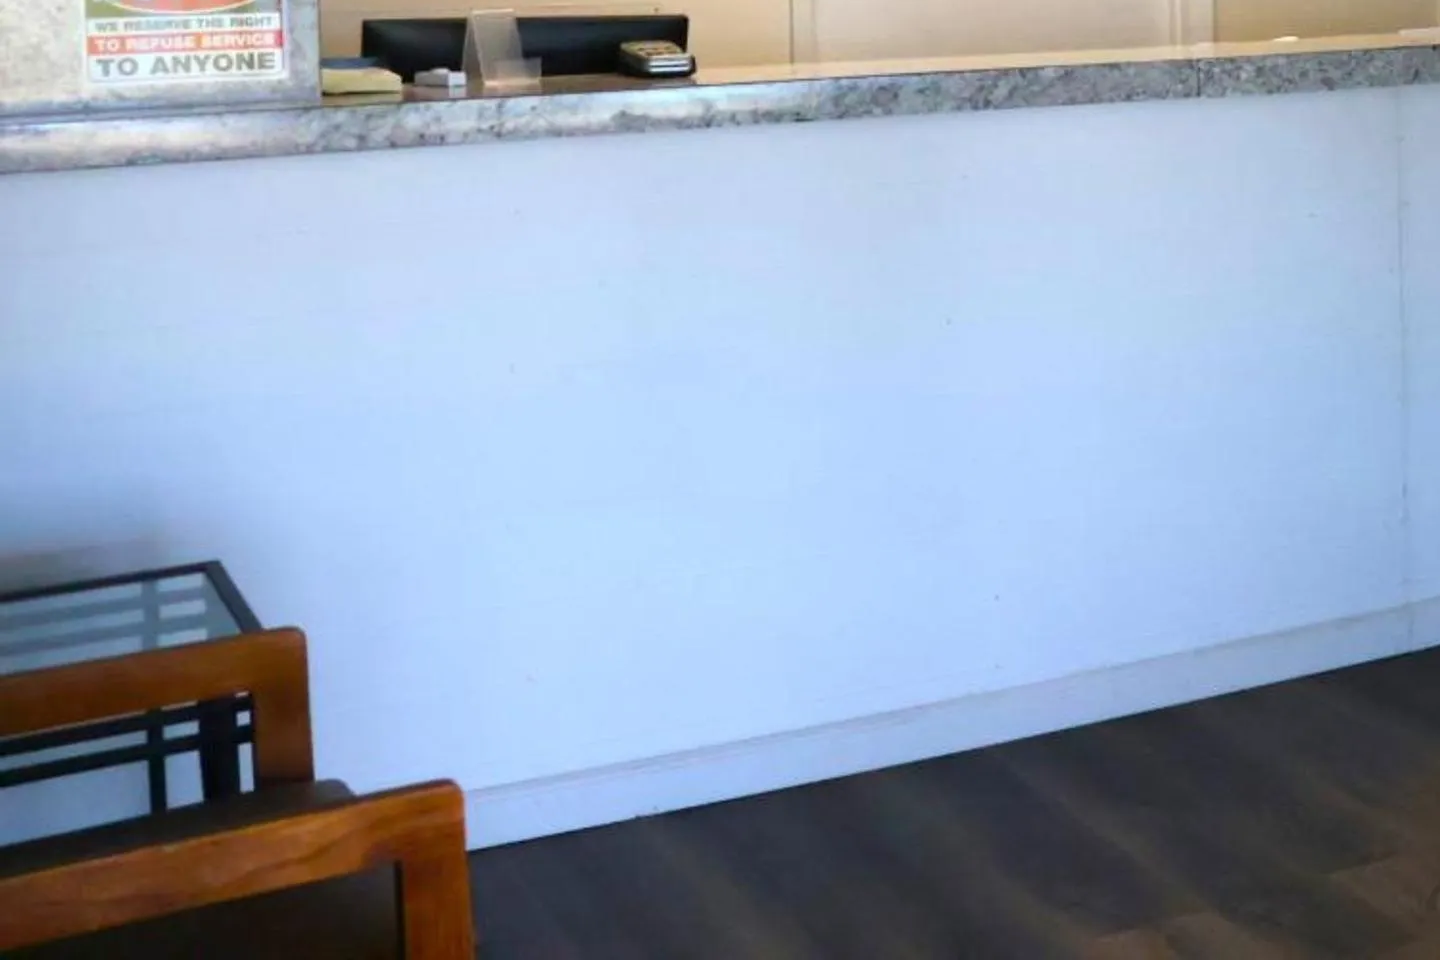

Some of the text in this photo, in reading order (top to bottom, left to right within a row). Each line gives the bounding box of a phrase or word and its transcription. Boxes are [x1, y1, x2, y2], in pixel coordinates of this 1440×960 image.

[95, 15, 272, 32] WE RESERVE THE RIGHT
[94, 32, 276, 53] TO REFUSE SERVICE
[95, 51, 276, 77] TO ANYONE
